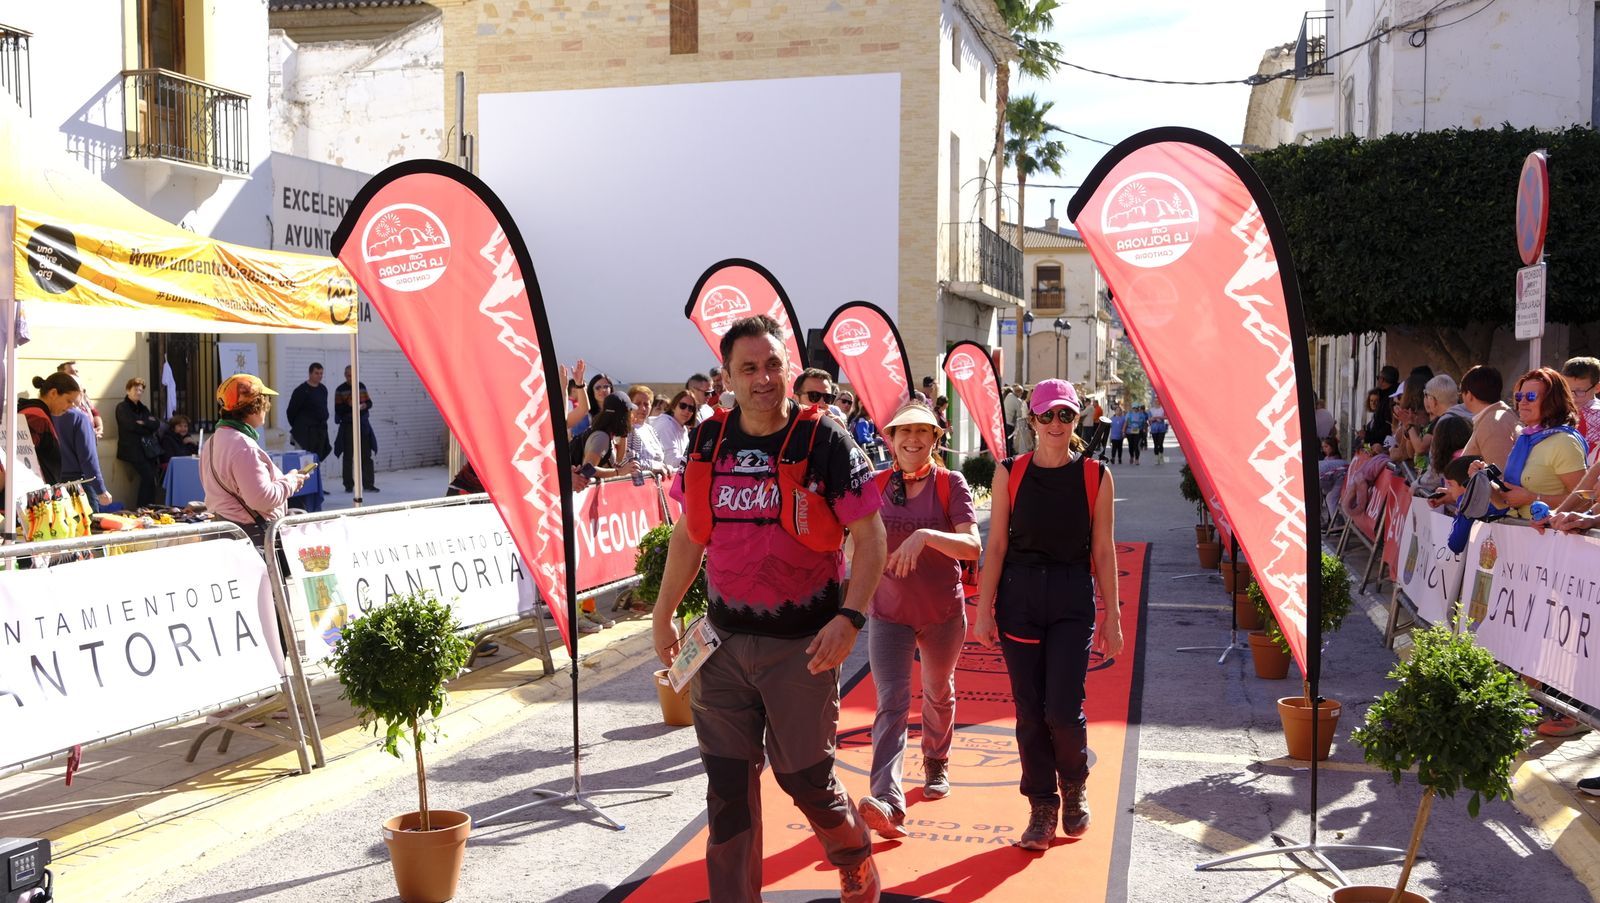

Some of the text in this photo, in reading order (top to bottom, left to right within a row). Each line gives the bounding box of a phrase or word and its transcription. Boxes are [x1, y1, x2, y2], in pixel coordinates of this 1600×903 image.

[283, 186, 352, 218] EXCELENT
[37, 245, 53, 254] uno
[580, 508, 650, 558] VEOLIA
[352, 534, 488, 568] AYUNTAMIENTO
[356, 553, 525, 612] CANTORIA
[4, 579, 241, 645] NTAMIENTO DE
[972, 824, 1014, 834] de
